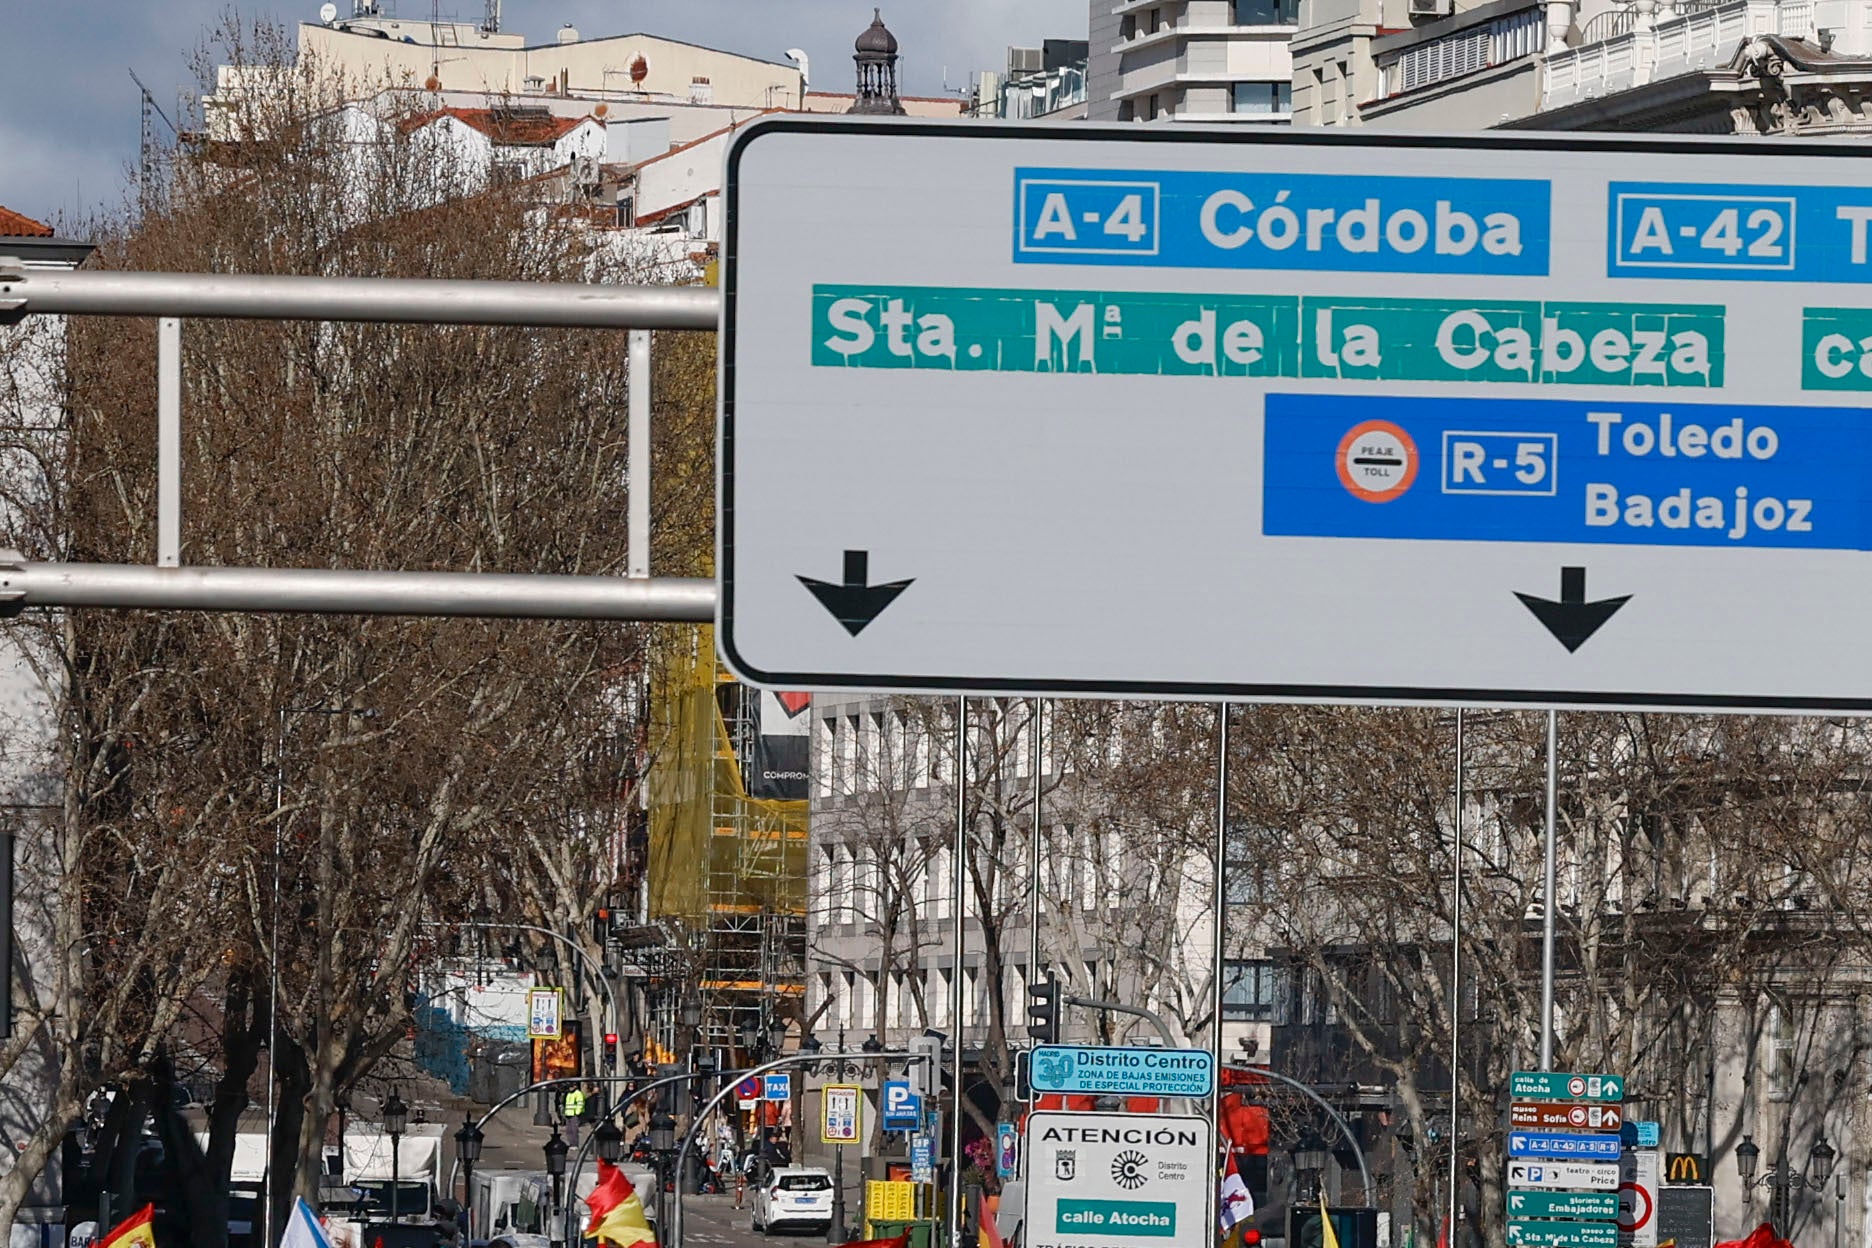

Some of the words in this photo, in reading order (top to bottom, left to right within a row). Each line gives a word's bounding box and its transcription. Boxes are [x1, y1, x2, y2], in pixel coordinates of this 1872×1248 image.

[1033, 193, 1148, 242] A-4
[1200, 190, 1524, 257] Córdoba
[1628, 205, 1784, 260] A-42
[824, 297, 984, 358] Sta.
[1172, 310, 1265, 366] de
[1316, 310, 1382, 369] la
[1436, 309, 1710, 379] Cabeza
[1586, 412, 1780, 461] Toledo
[1360, 445, 1395, 457] PEAJE
[1451, 441, 1547, 486] R-5
[1363, 466, 1391, 477] TOLL
[1585, 485, 1814, 541] Badajoz
[1077, 1051, 1140, 1068] Distrito
[1144, 1054, 1208, 1070] Centro
[1078, 1069, 1104, 1080] ZONA
[1106, 1070, 1119, 1081] DE
[1121, 1071, 1153, 1081] BAJAS
[1154, 1072, 1205, 1083] EMISIONES
[1538, 1076, 1549, 1084] de
[767, 1083, 788, 1092] TAXI
[1080, 1080, 1093, 1089] DE
[1094, 1080, 1140, 1091] ESPECIAL
[1142, 1080, 1203, 1093] PROTECCIÓN
[1514, 1083, 1551, 1094] Atocha
[1511, 1113, 1538, 1123] Reina
[1041, 1127, 1197, 1146] ATENCIÓN
[1531, 1140, 1547, 1150] A-4
[1157, 1161, 1188, 1171] Distrito
[1157, 1170, 1185, 1181] Centro
[1590, 1176, 1616, 1184] Price
[1548, 1203, 1614, 1215] Embajadores
[1061, 1210, 1104, 1225] calle
[1109, 1211, 1170, 1227] Atocha
